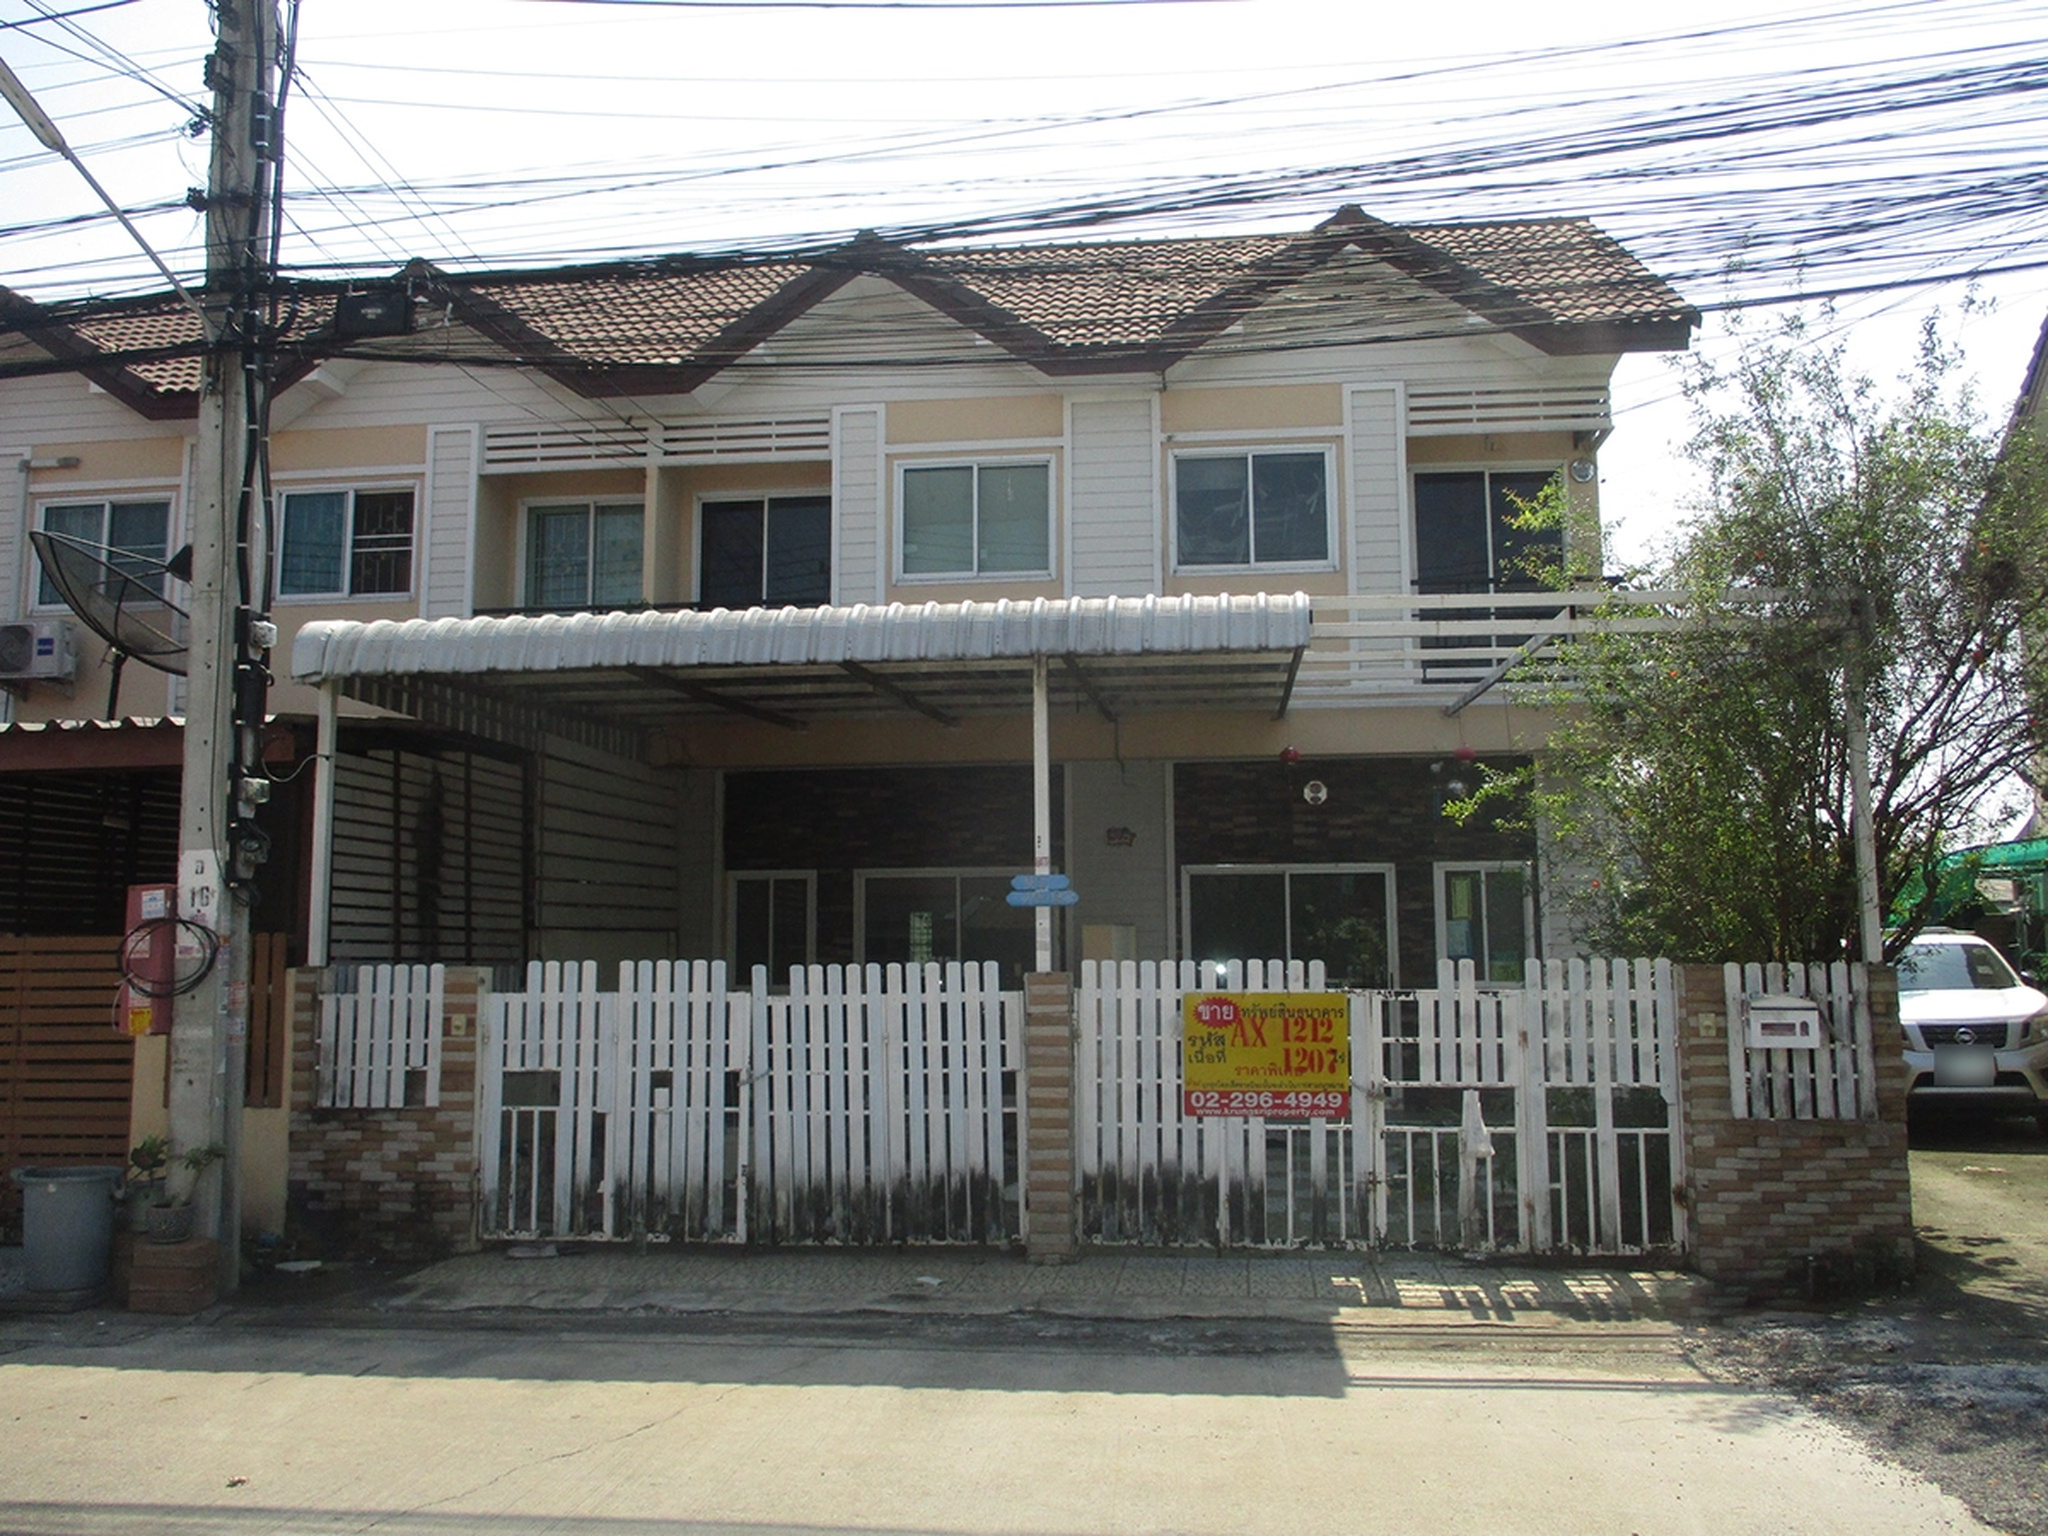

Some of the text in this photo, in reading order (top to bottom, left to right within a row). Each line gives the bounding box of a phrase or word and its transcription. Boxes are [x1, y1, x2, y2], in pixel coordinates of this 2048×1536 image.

[1197, 1004, 1234, 1021] ขาย
[1187, 1031, 1226, 1048] รหัส
[1230, 1016, 1335, 1048] AX 1212
[1283, 1047, 1338, 1075] 1207
[1190, 1091, 1343, 1109] 02-296-4949
